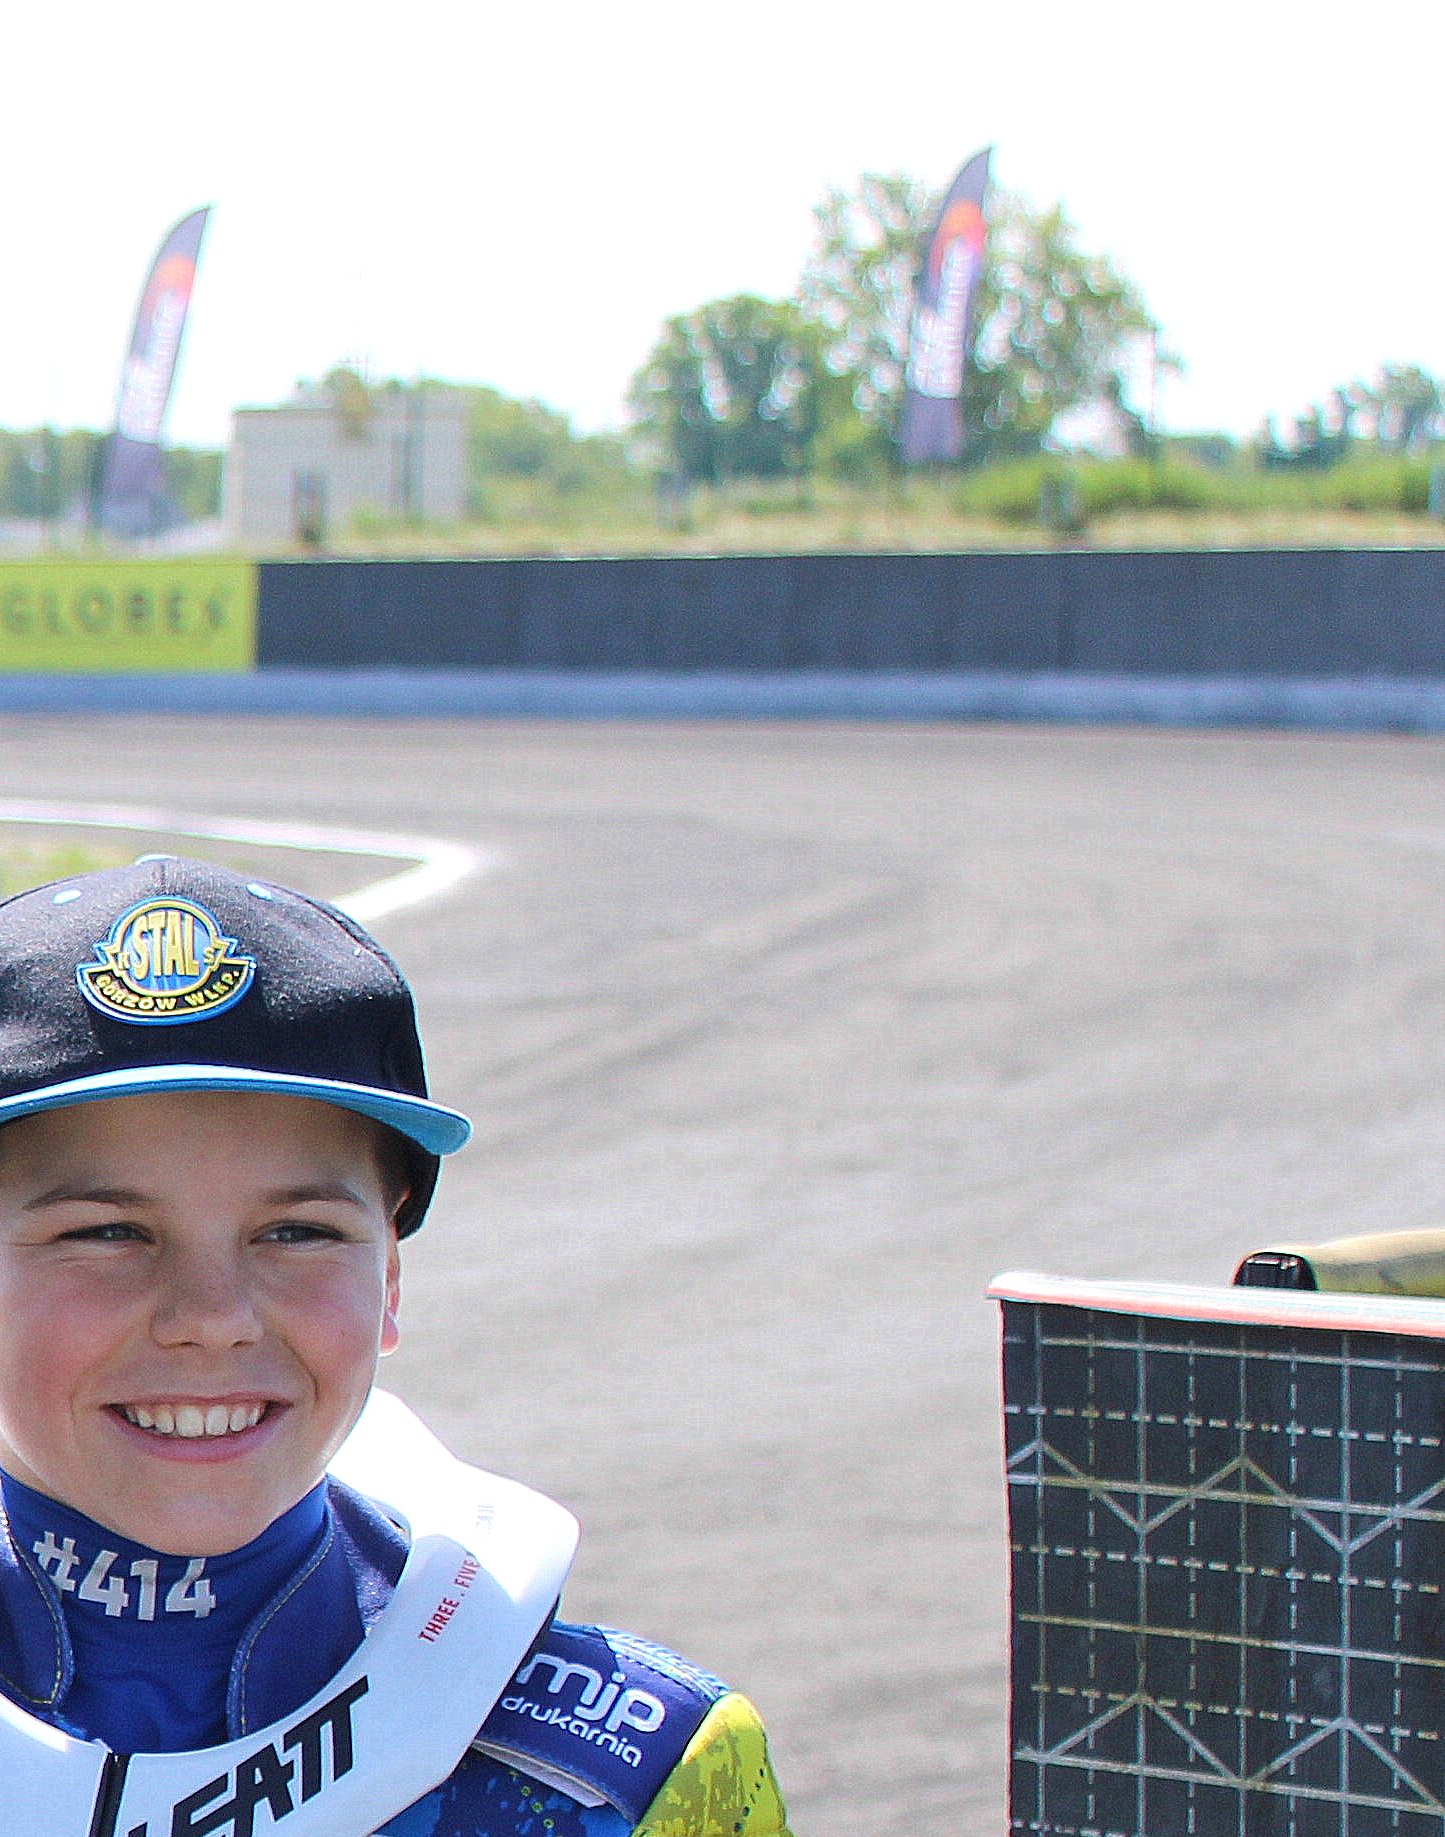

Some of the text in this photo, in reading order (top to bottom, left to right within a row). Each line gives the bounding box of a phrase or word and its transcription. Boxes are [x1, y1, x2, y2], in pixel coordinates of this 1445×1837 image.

[133, 911, 200, 980] STAL
[96, 973, 177, 1011] GORZÓW
[33, 1531, 217, 1622] #414
[417, 1598, 460, 1644] THREE
[515, 1652, 666, 1737] mjp
[500, 1694, 643, 1769] drukarnia
